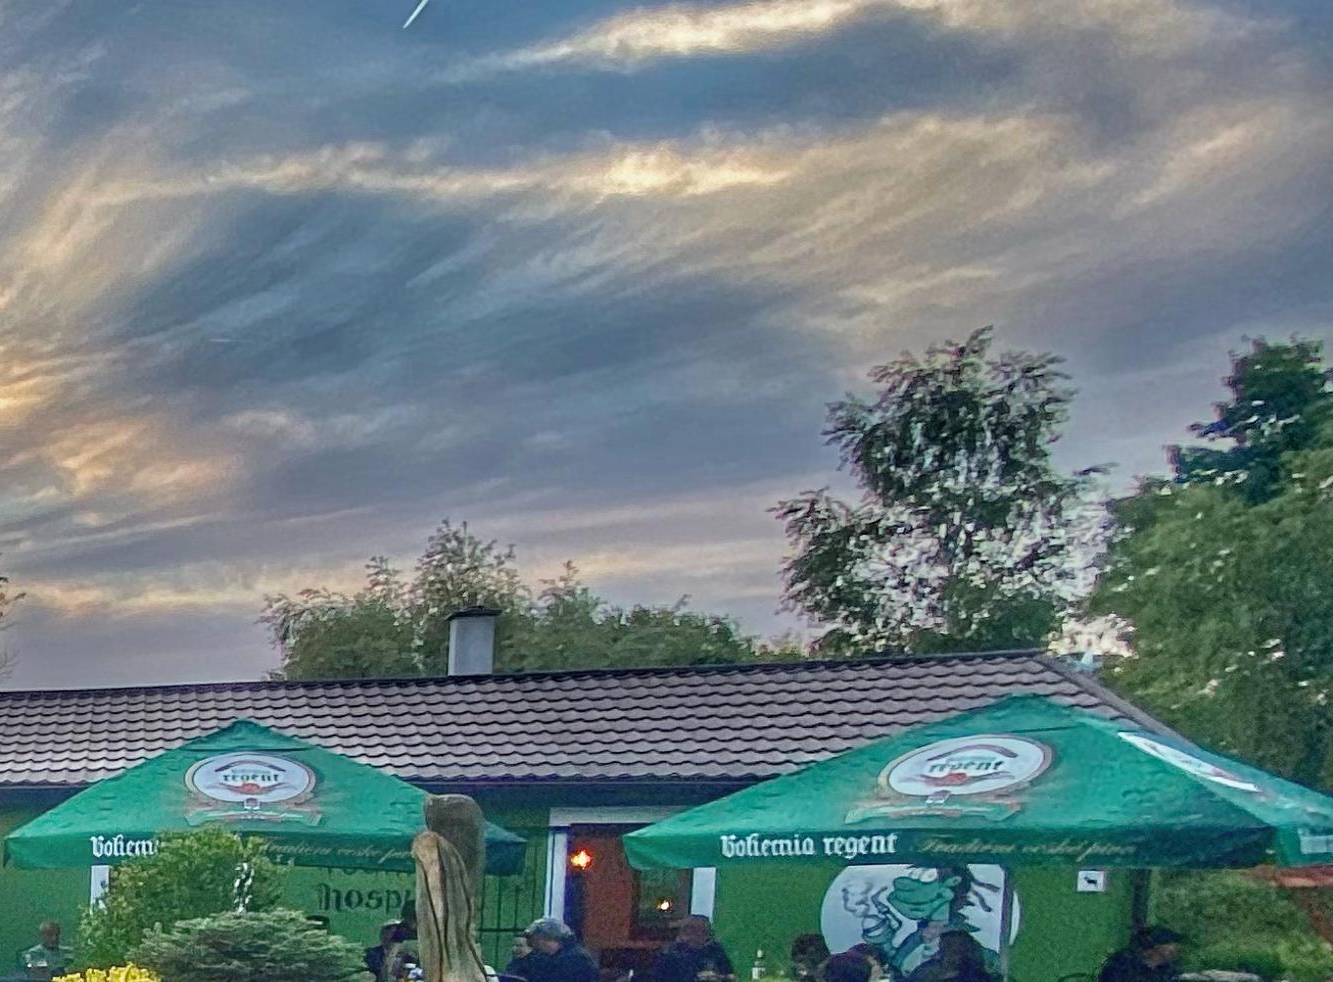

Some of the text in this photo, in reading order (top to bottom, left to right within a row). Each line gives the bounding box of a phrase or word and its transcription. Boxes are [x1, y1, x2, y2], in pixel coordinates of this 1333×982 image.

[90, 834, 160, 857] Bohem
[720, 832, 898, 860] Bohemia regent
[311, 882, 412, 914] Hosp
